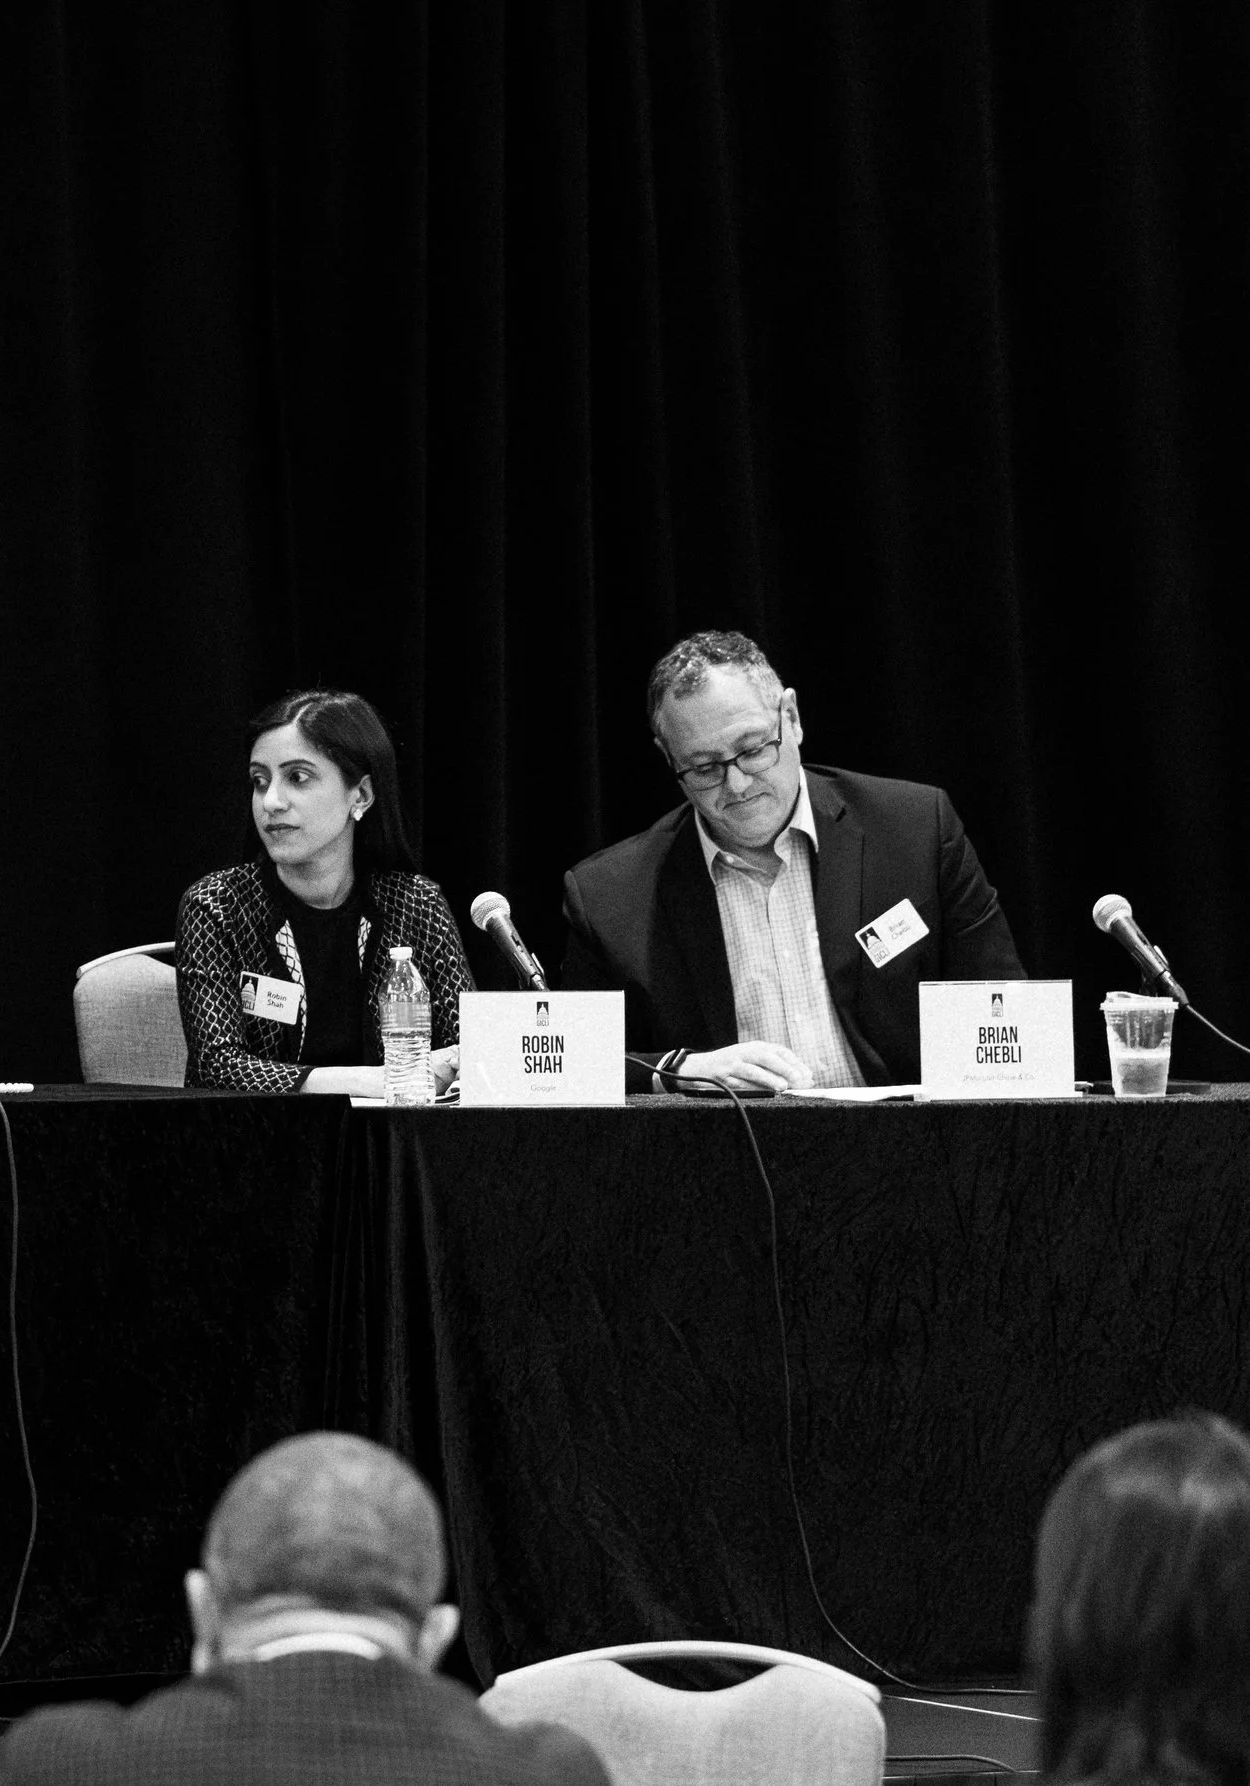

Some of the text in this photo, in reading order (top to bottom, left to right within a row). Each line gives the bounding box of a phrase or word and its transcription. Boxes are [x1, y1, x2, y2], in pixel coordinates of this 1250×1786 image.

[267, 990, 288, 1002] Robin
[267, 998, 285, 1009] Shah
[522, 1035, 565, 1054] ROBIN
[978, 1026, 1019, 1045] BRIAN
[976, 1045, 1022, 1064] CHEBLI
[524, 1055, 563, 1074] SHAH
